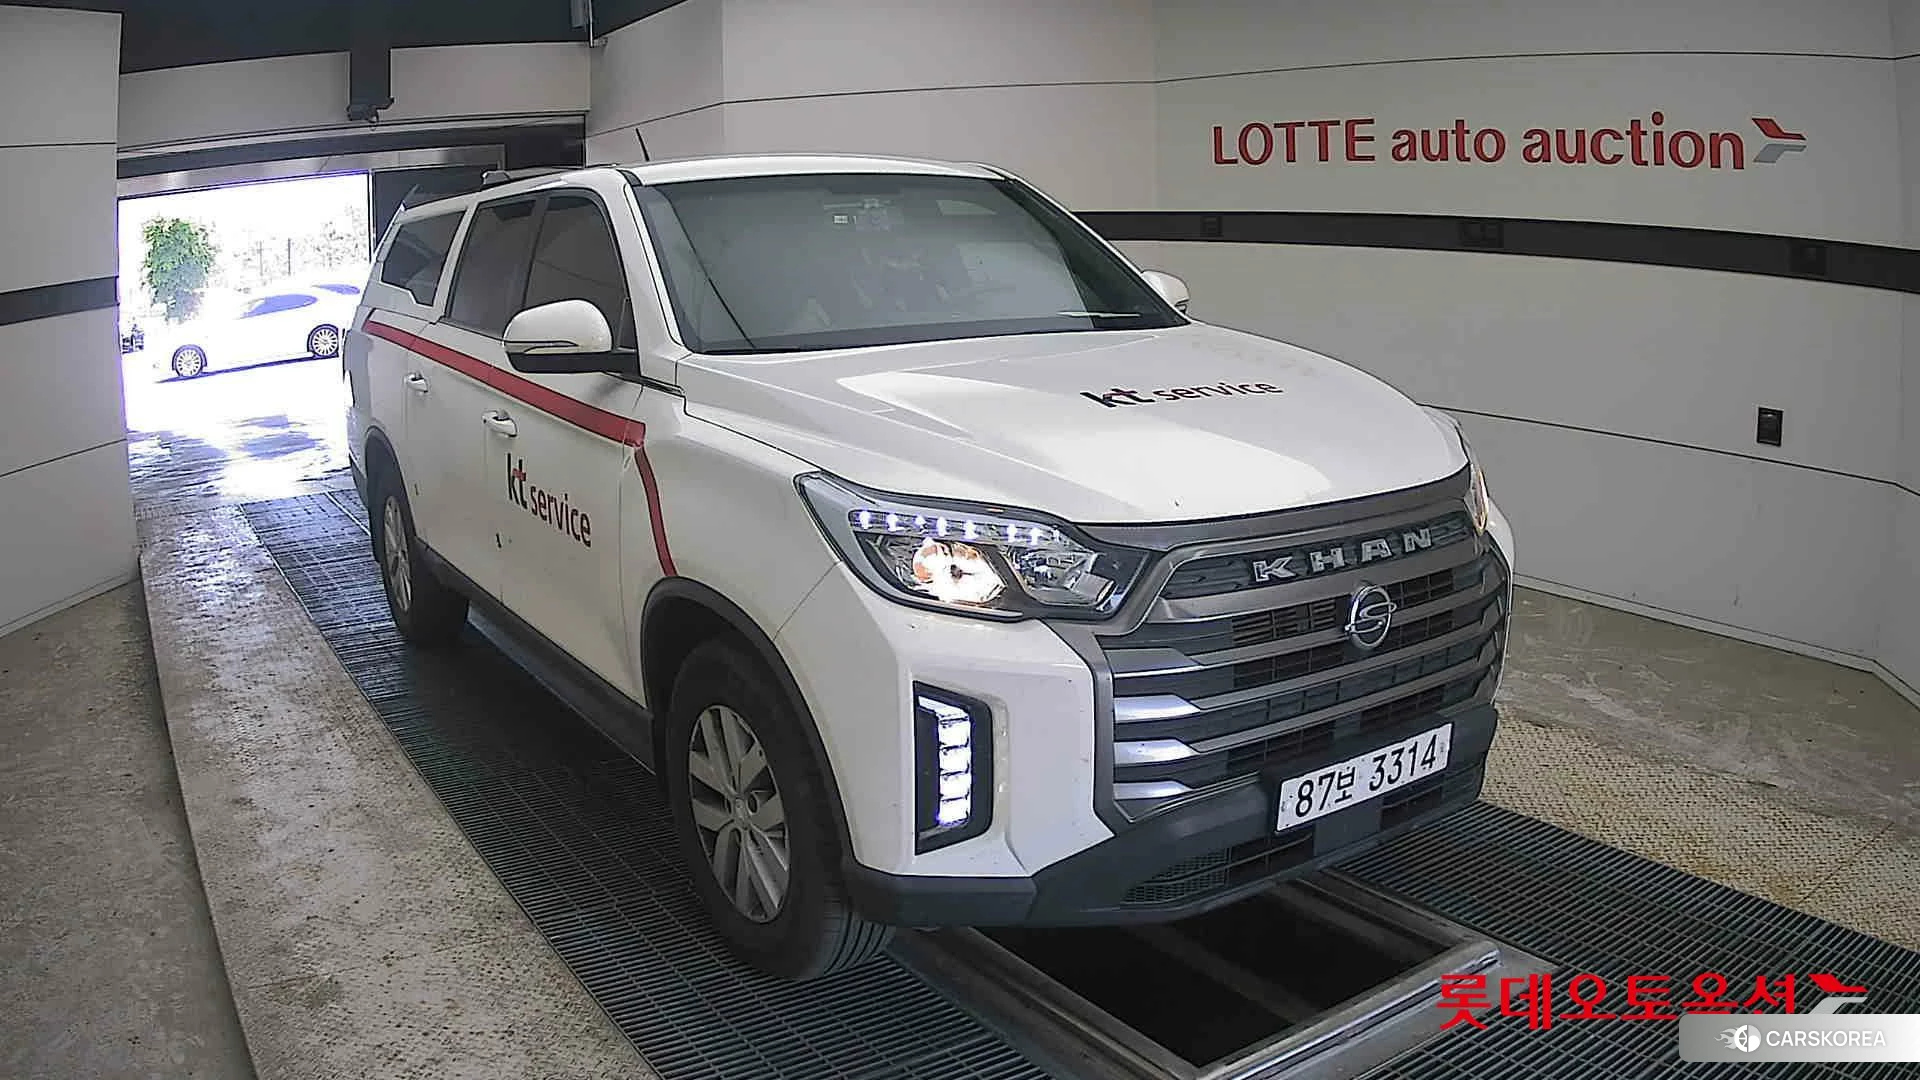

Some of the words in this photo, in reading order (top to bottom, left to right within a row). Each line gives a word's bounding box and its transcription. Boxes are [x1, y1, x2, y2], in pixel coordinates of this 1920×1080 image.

[1212, 117, 1376, 166] LOTTE
[1390, 119, 1507, 164] auto
[1521, 111, 1746, 170] auction
[1079, 387, 1156, 408] kt
[1152, 381, 1284, 401] service
[506, 452, 528, 510] kt
[530, 485, 592, 548] service
[1252, 527, 1434, 583] KHAN
[1294, 765, 1357, 818] 87보
[1368, 733, 1438, 792] 3314
